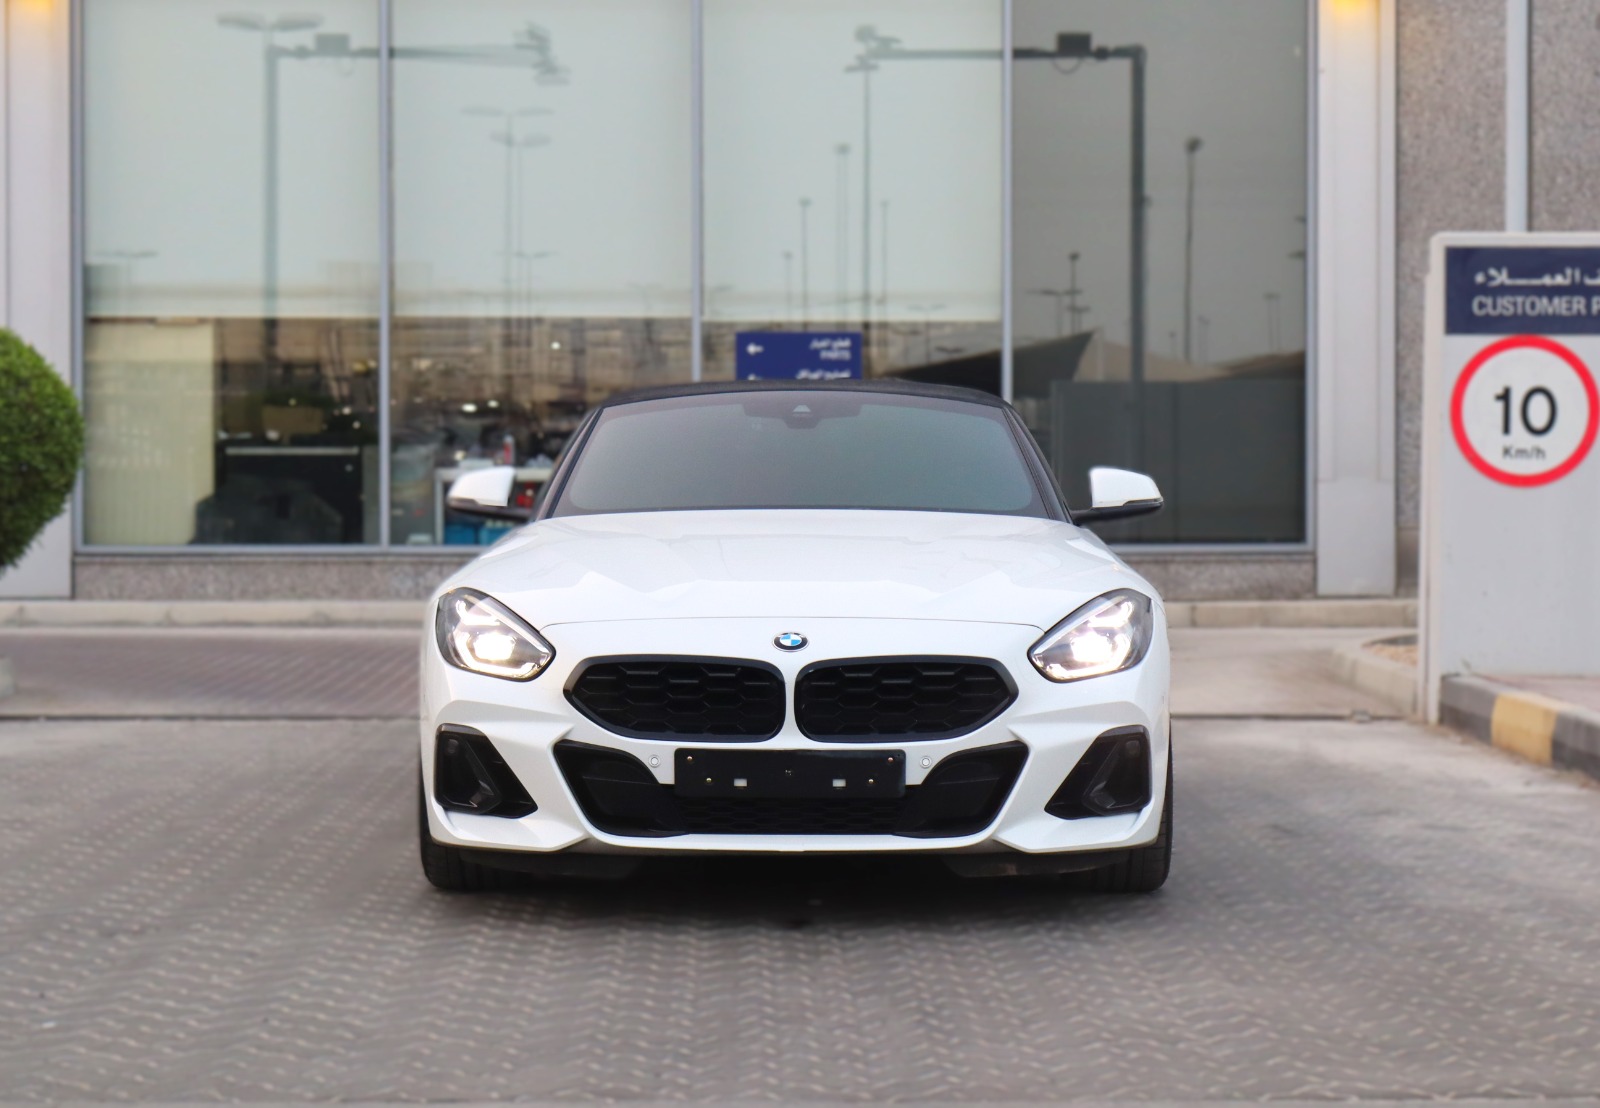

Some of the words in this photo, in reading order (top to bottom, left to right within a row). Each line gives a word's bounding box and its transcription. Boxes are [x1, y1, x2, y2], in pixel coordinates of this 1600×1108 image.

[1472, 294, 1587, 317] CUSTOMER
[1494, 386, 1558, 437] 10
[1502, 446, 1546, 459] Km/h
